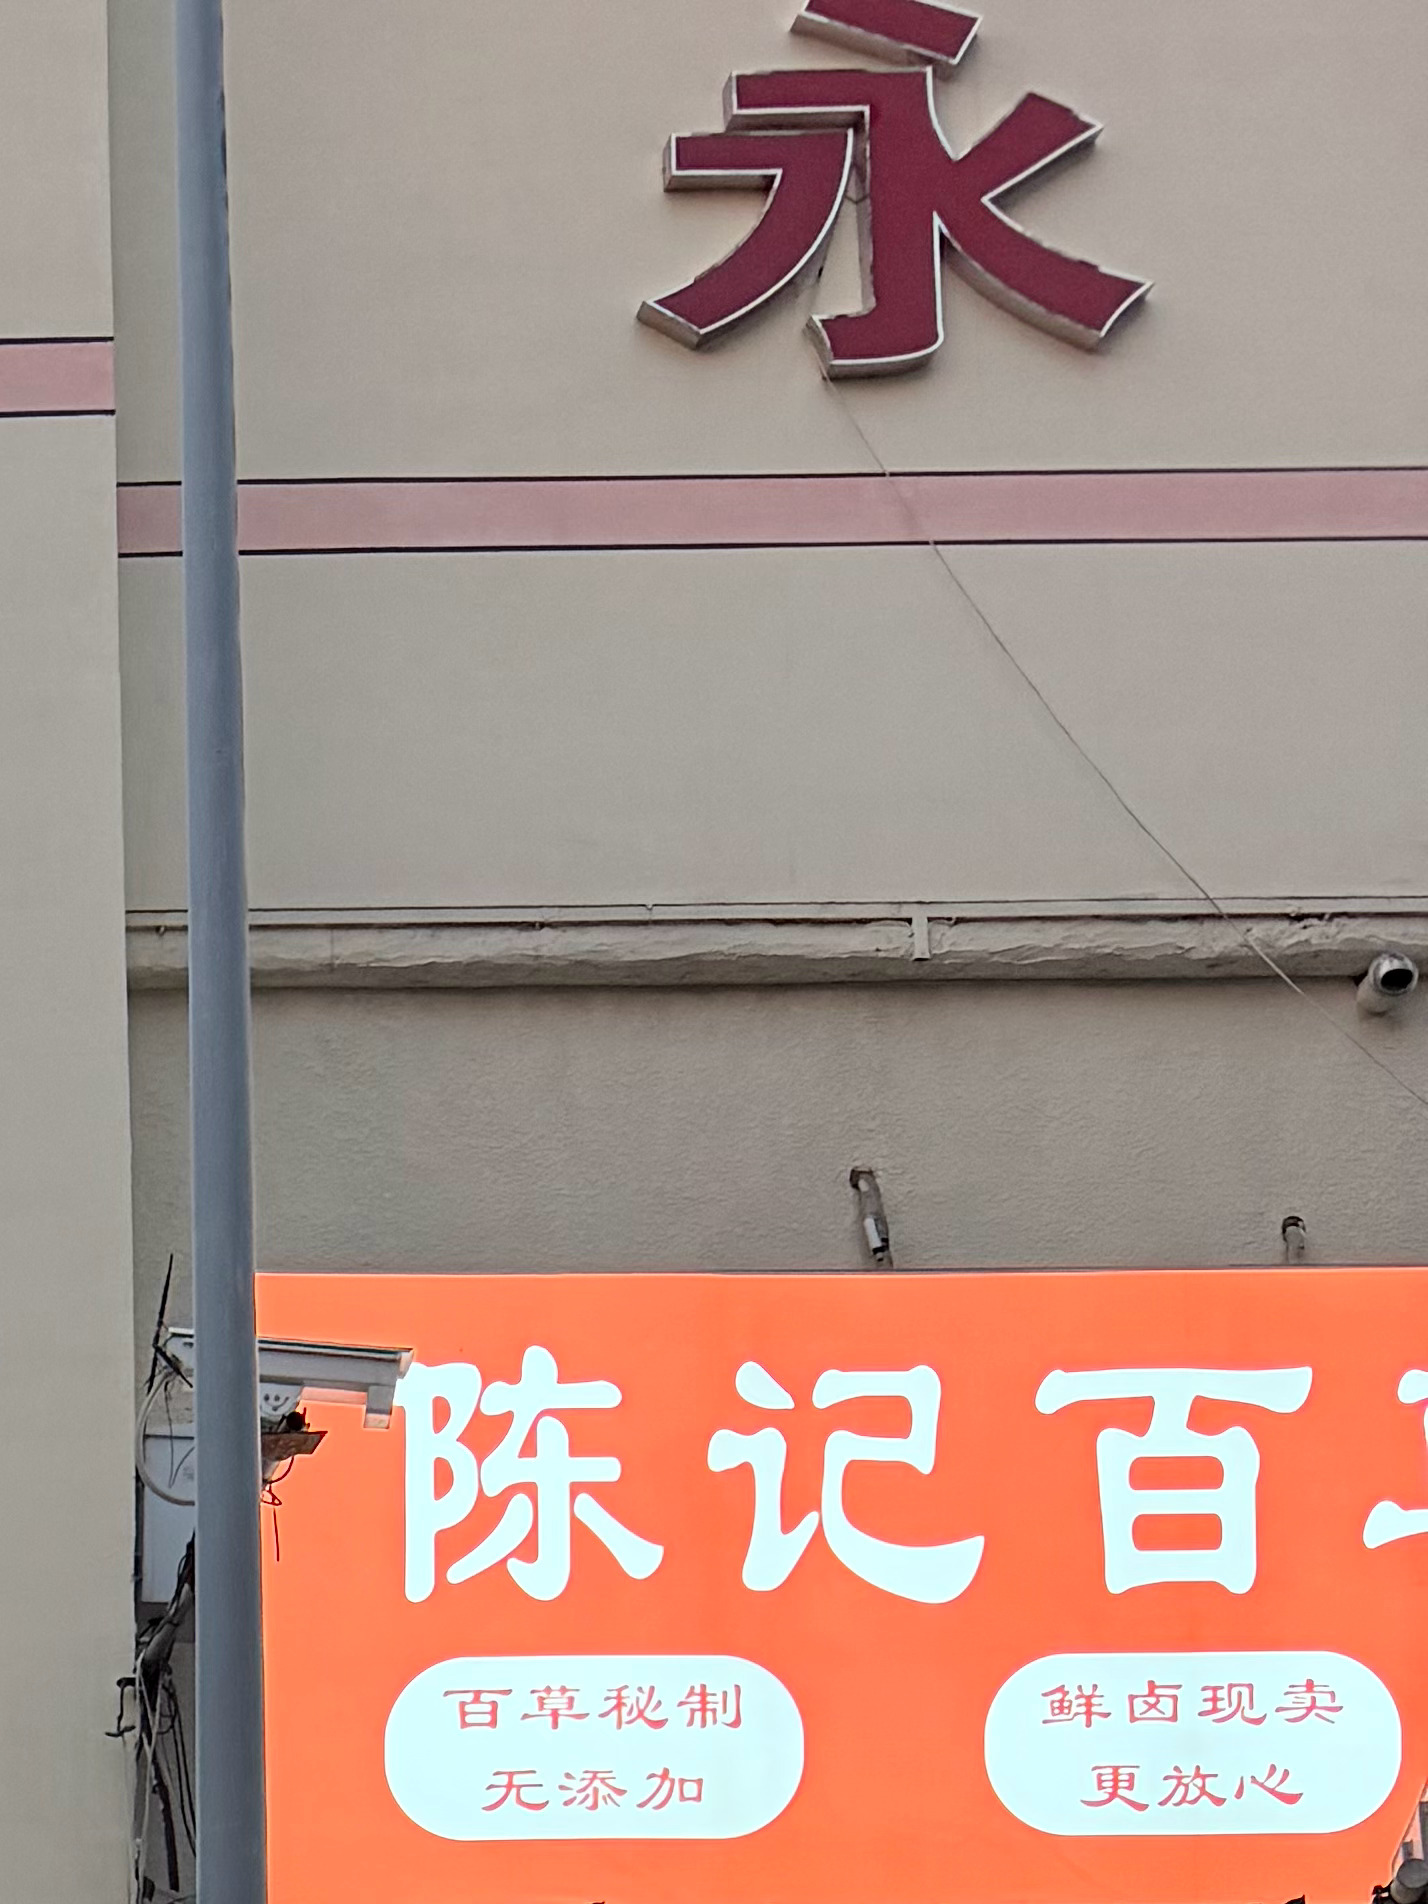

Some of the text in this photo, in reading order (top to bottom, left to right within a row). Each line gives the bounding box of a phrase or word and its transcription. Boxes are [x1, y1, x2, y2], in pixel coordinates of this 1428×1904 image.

[636, 0, 1154, 380] 永
[394, 1344, 1428, 1604] 陈记百
[442, 1682, 744, 1732] 百草秘制
[1040, 1678, 1345, 1728] 鲜卤现卖
[481, 1767, 705, 1814] 无添加
[1079, 1762, 1305, 1809] 更放心
